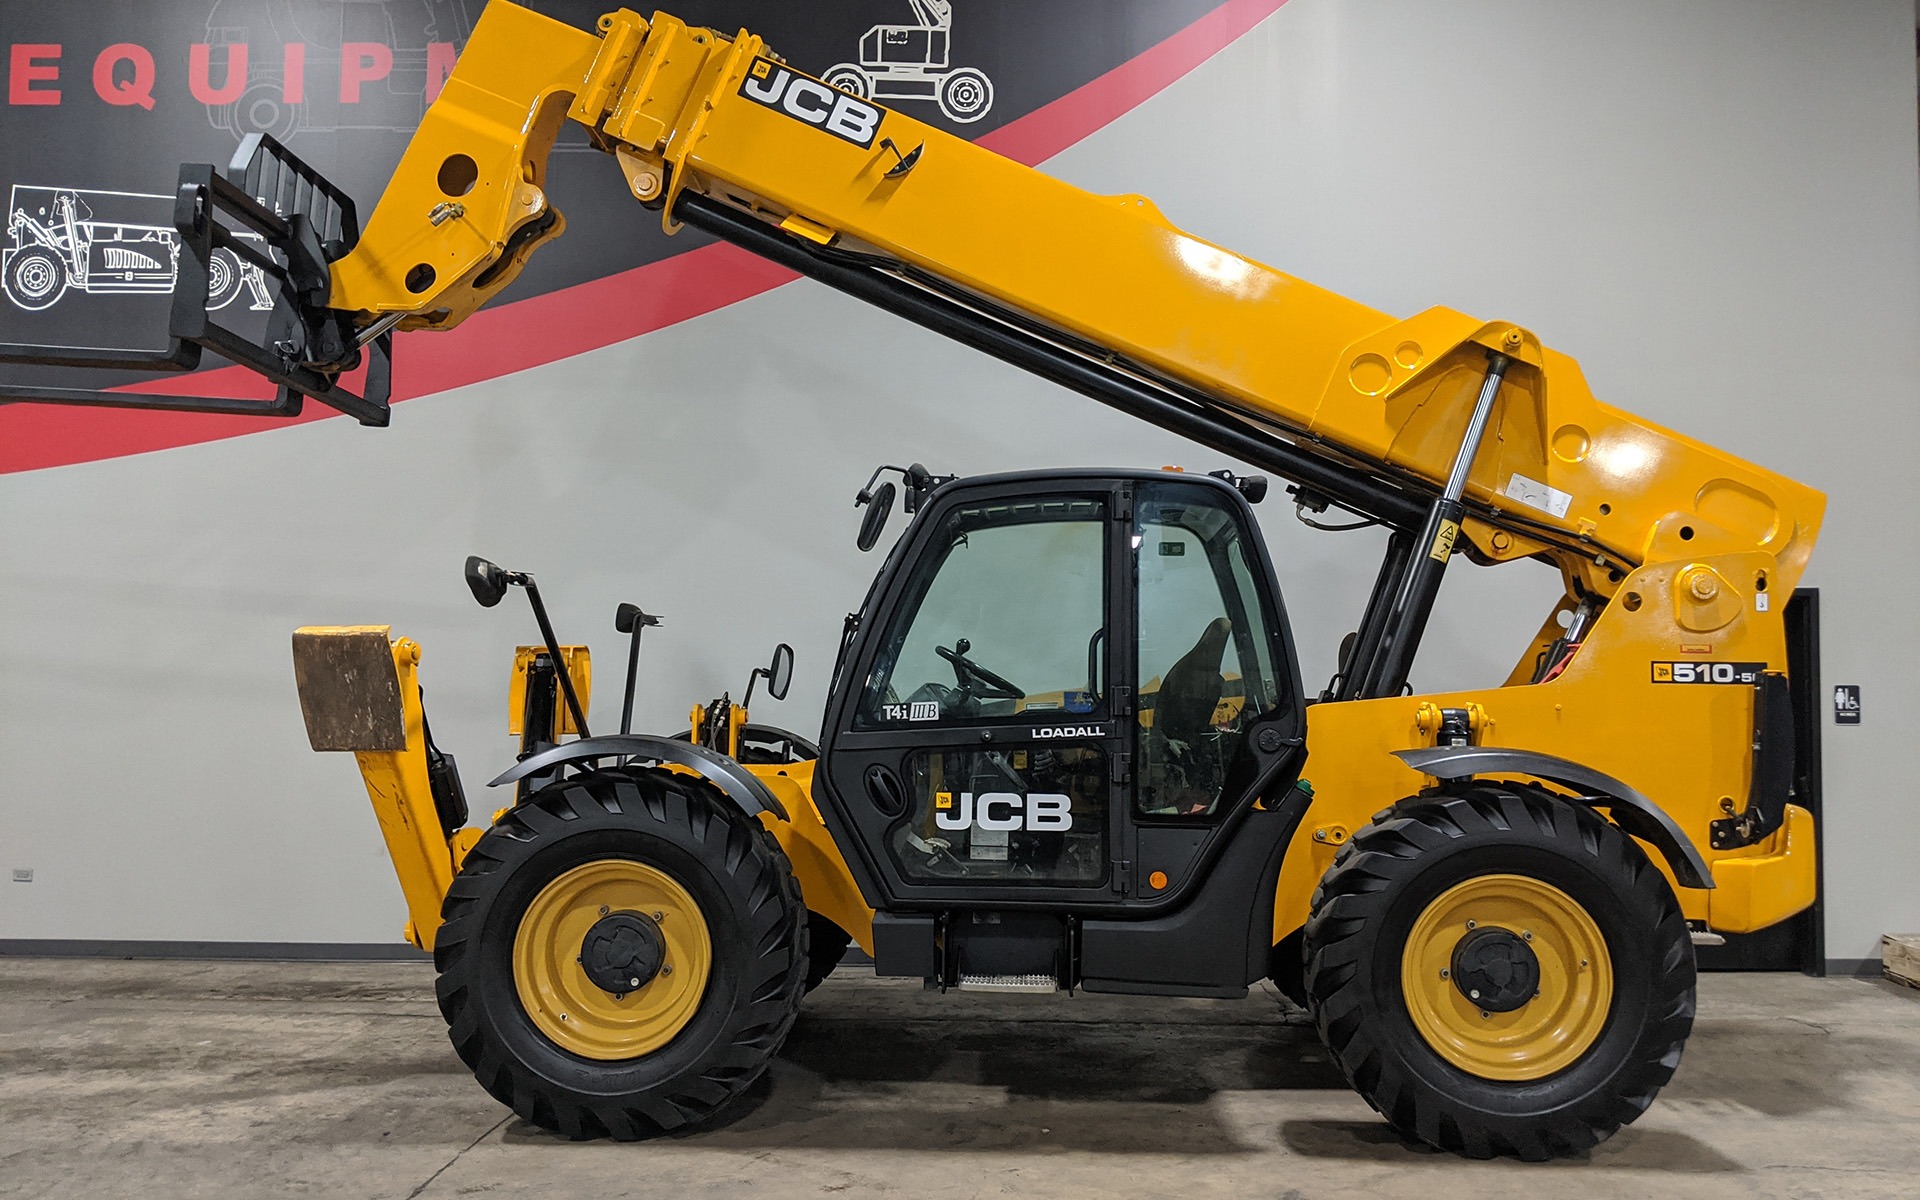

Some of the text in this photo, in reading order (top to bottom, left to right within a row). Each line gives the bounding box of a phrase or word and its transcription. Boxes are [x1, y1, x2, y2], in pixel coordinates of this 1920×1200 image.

[745, 69, 879, 143] JCB
[1673, 663, 1756, 683] 510-5
[882, 704, 909, 720] T4i
[1031, 726, 1106, 739] LOADALL
[935, 792, 1073, 832] JCB
